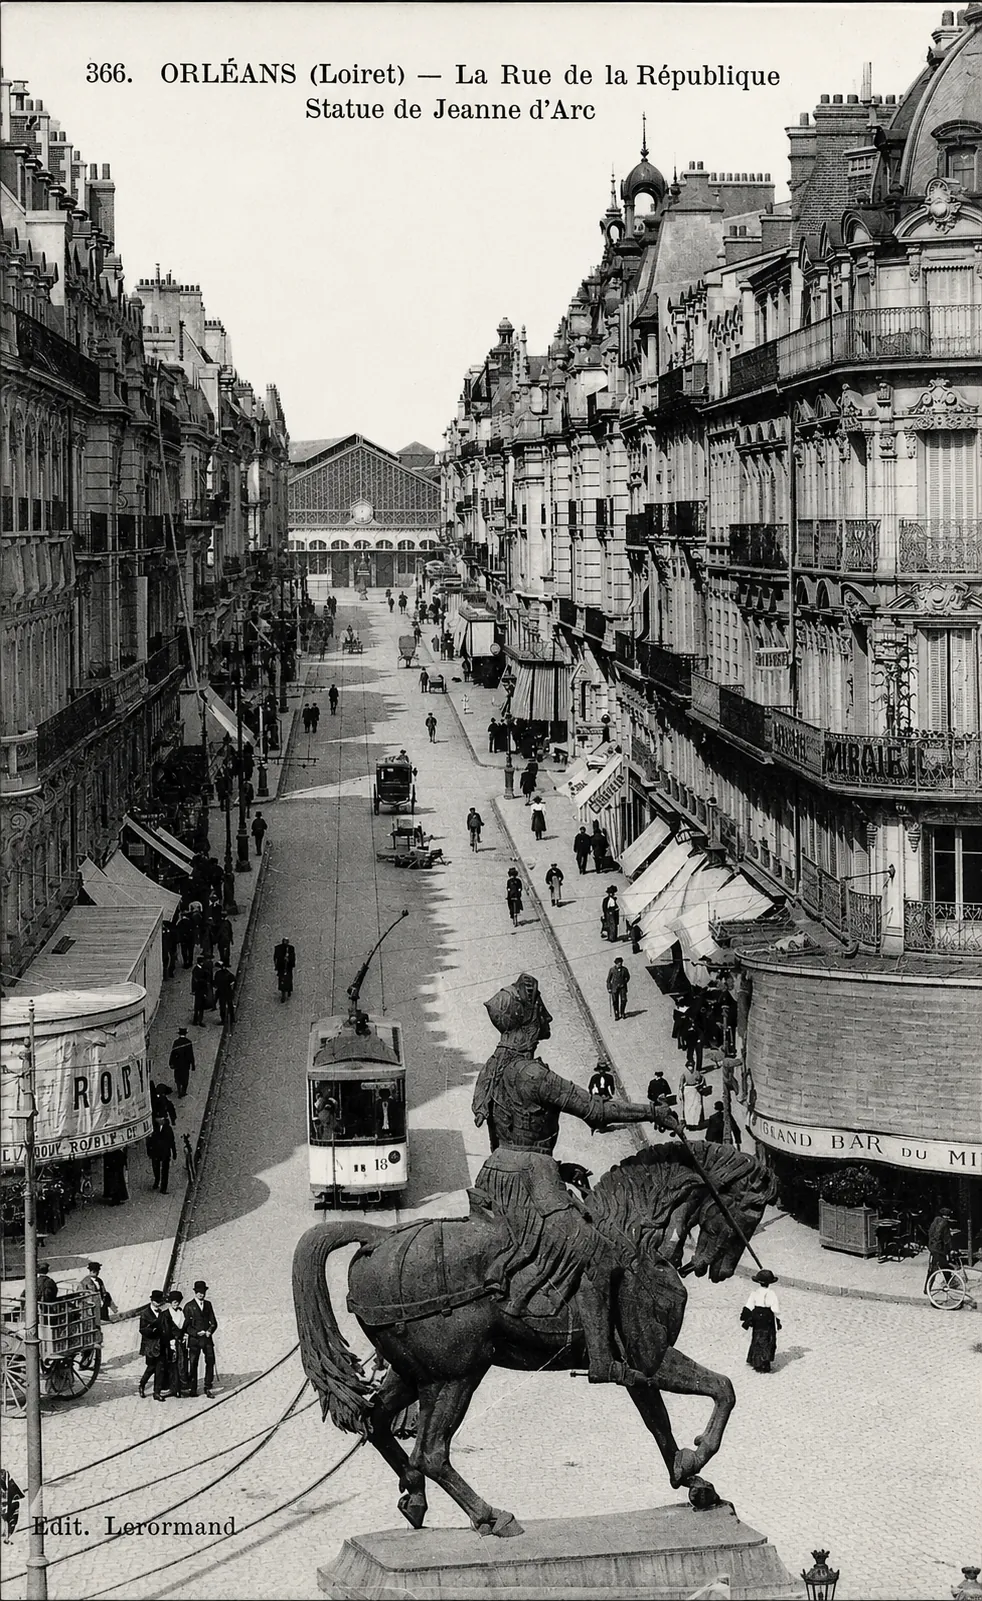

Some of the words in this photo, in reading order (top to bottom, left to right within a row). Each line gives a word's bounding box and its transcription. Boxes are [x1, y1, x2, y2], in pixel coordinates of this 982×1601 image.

[831, 1134, 883, 1154] BAR
[901, 1147, 928, 1160] DU
[374, 1158, 389, 1171] 18
